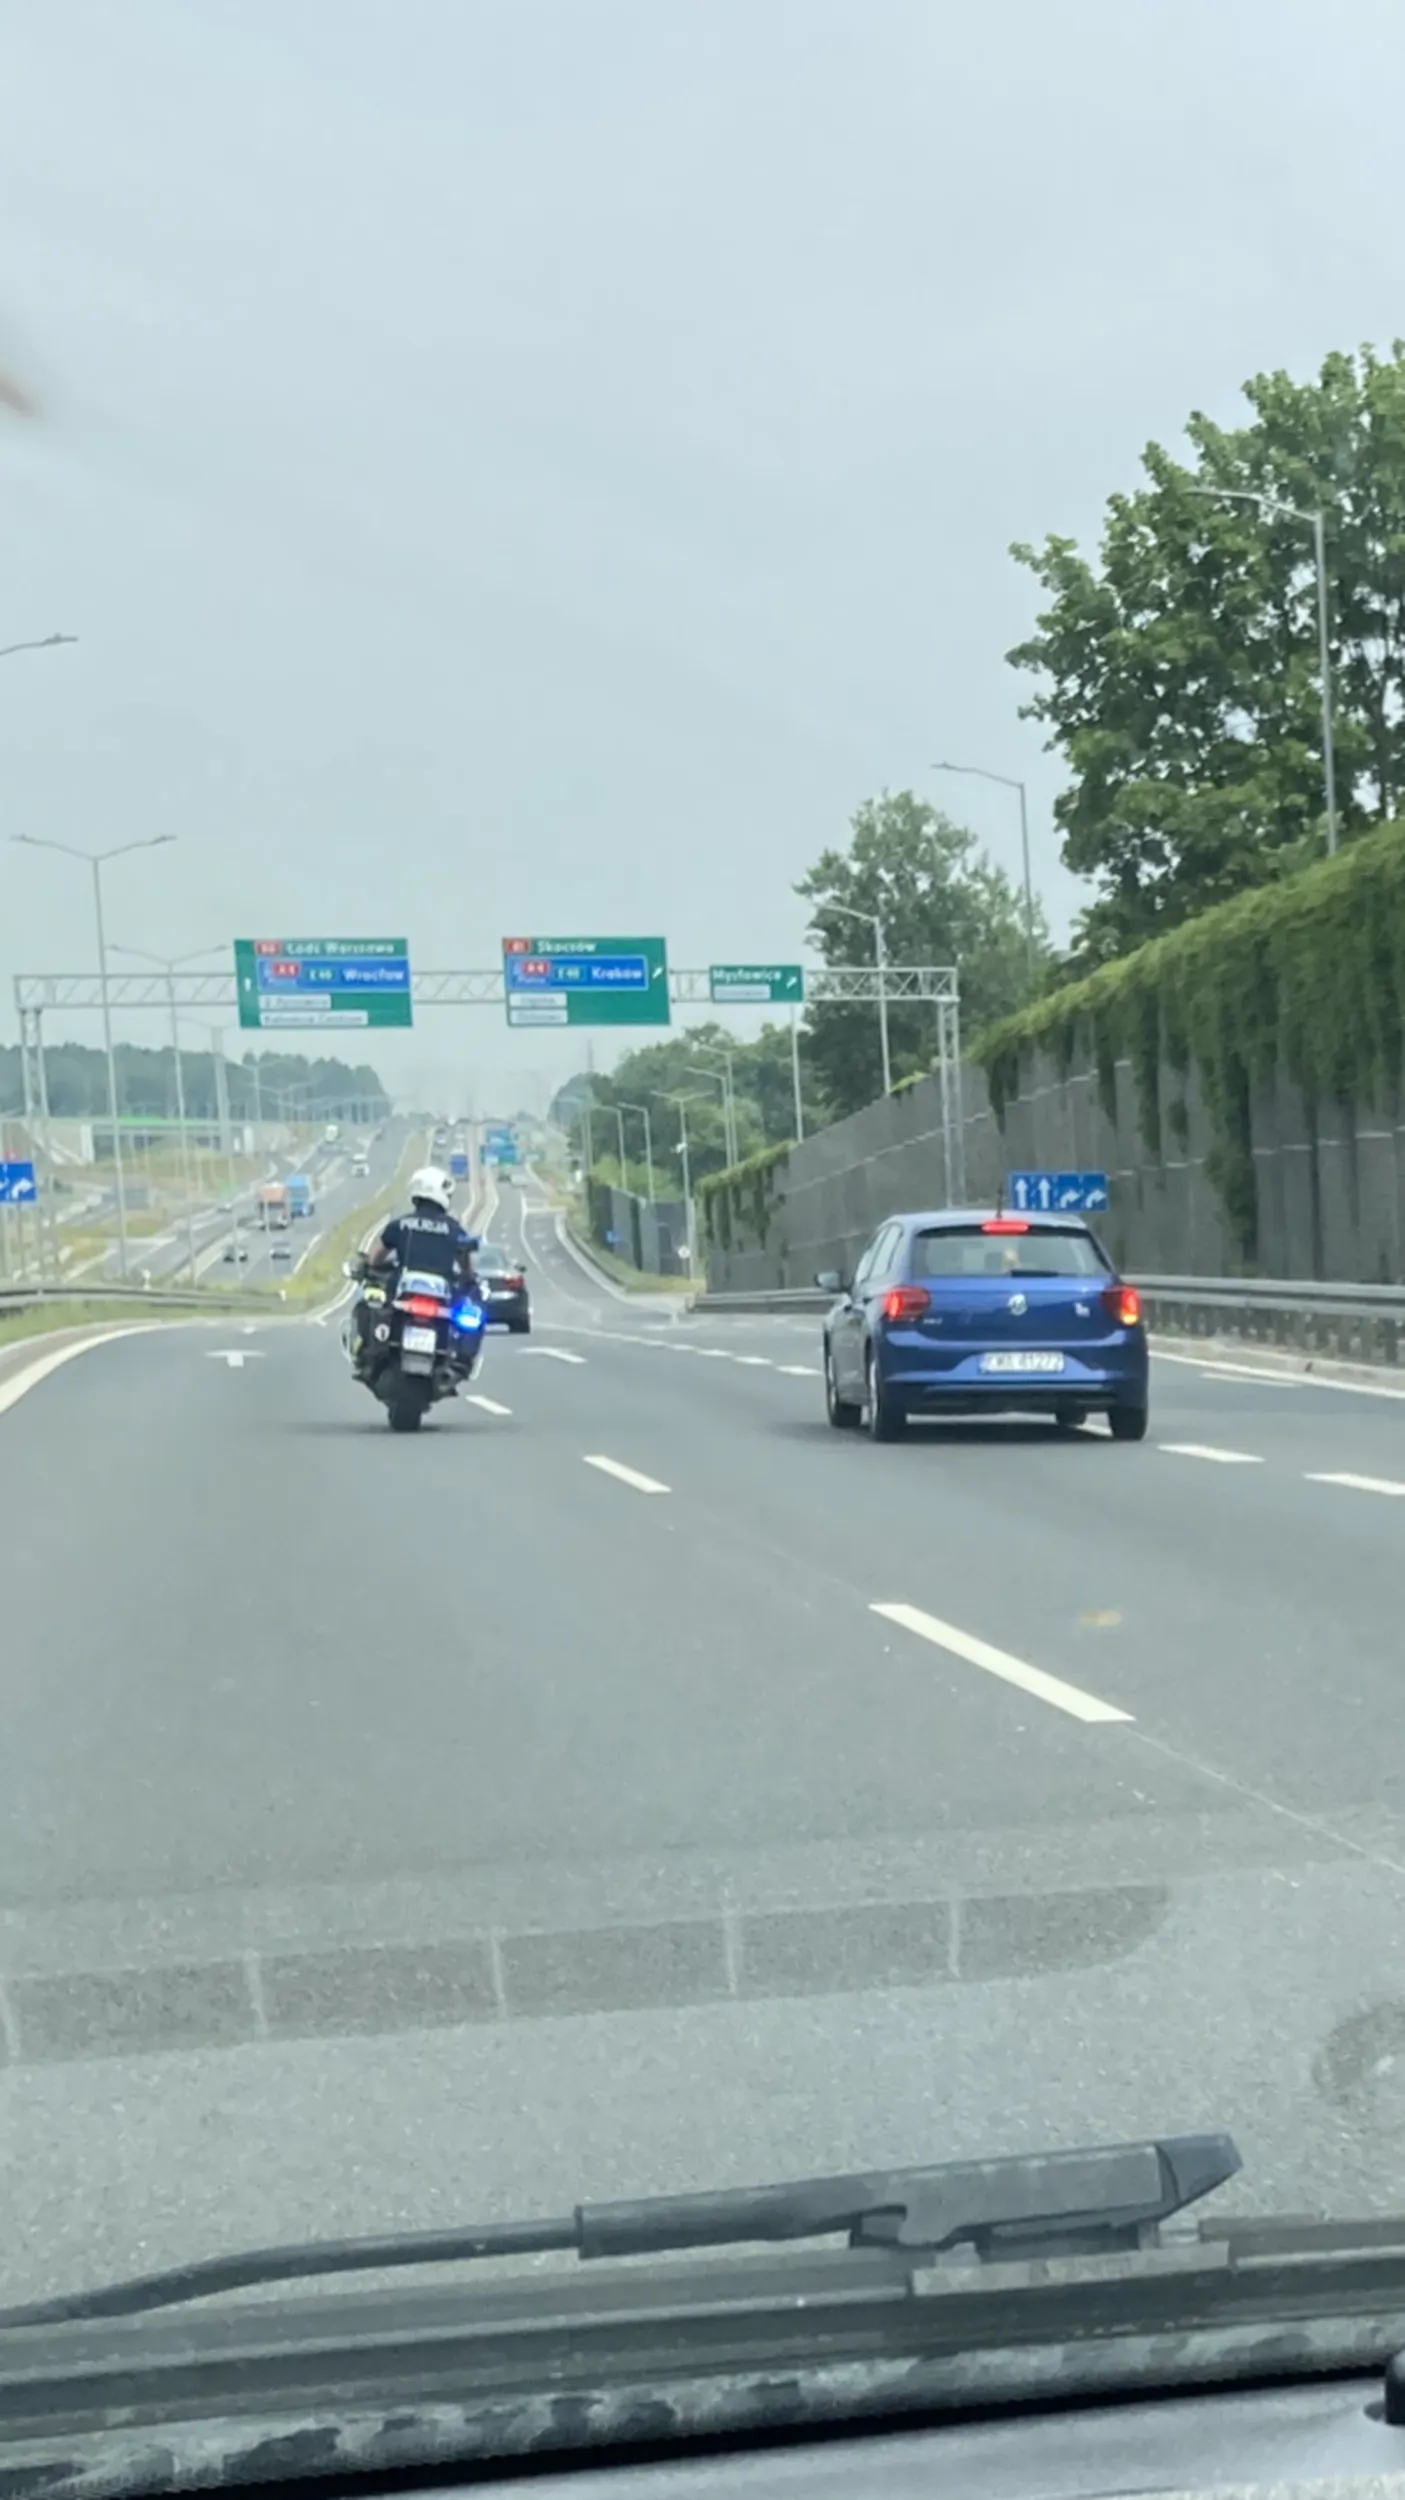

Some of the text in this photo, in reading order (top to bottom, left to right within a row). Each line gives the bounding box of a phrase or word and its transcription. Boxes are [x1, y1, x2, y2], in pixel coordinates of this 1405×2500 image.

[343, 968, 405, 982] Wrocław
[591, 966, 643, 980] Kraków
[400, 1218, 450, 1235] POLICJA
